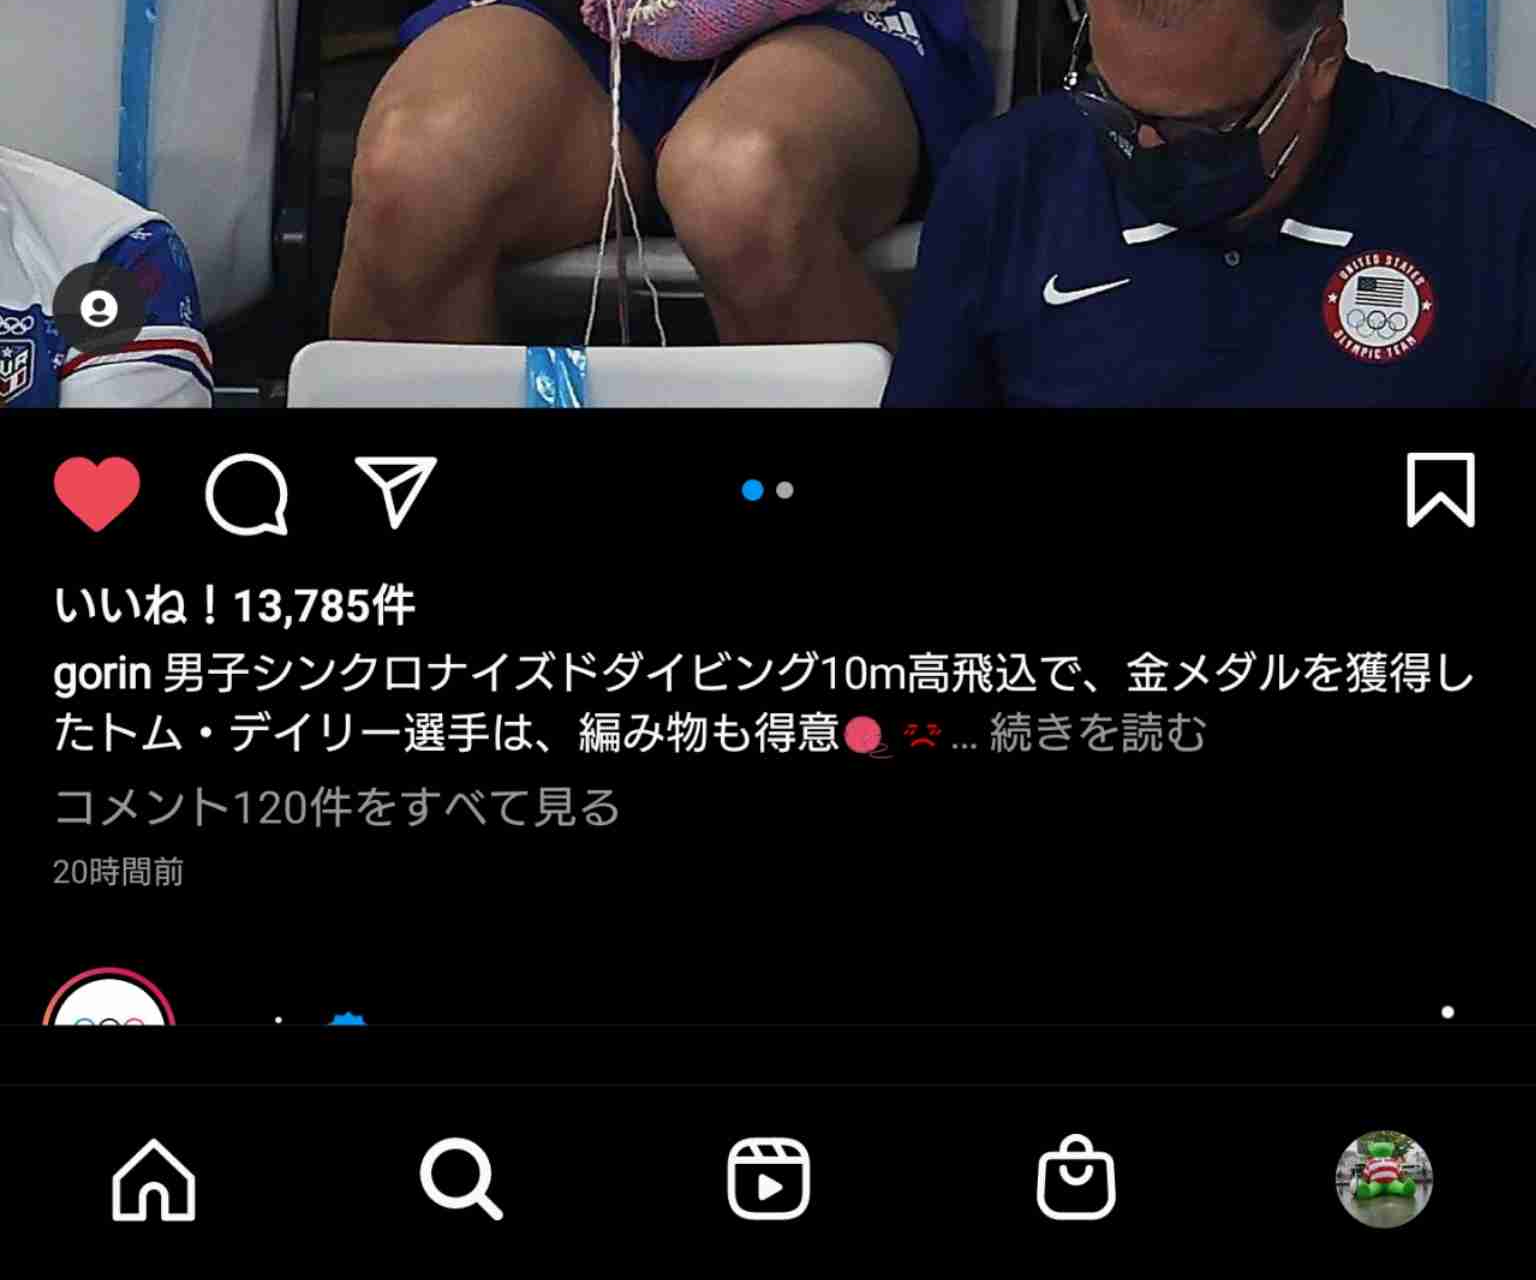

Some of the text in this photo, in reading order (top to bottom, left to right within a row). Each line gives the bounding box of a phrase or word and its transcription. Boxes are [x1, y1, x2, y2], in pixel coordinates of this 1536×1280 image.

[1339, 254, 1425, 286] UNITED STATES
[1333, 329, 1417, 360] OLYMPIC TEAM
